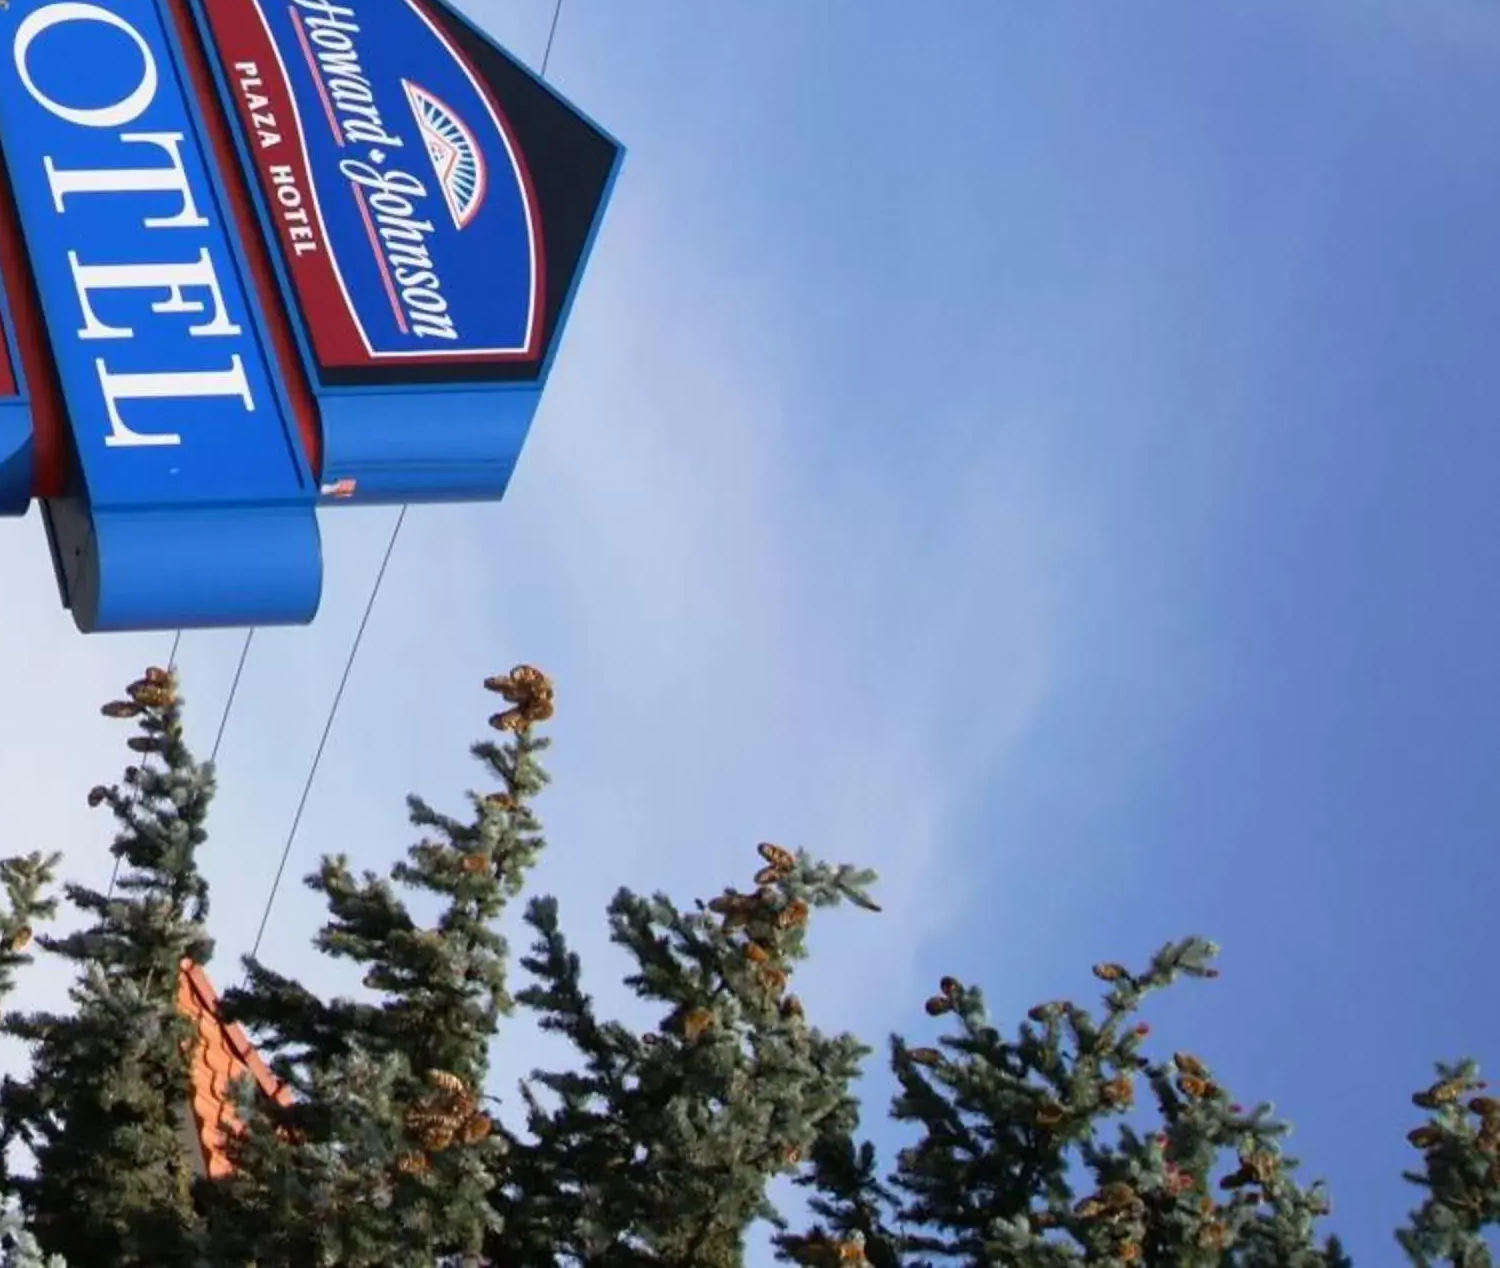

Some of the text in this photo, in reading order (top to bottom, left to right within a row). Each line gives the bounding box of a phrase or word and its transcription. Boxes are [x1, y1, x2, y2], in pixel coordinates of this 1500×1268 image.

[234, 61, 317, 257] PLAZA HOTEL
[339, 159, 458, 340] Johnson
